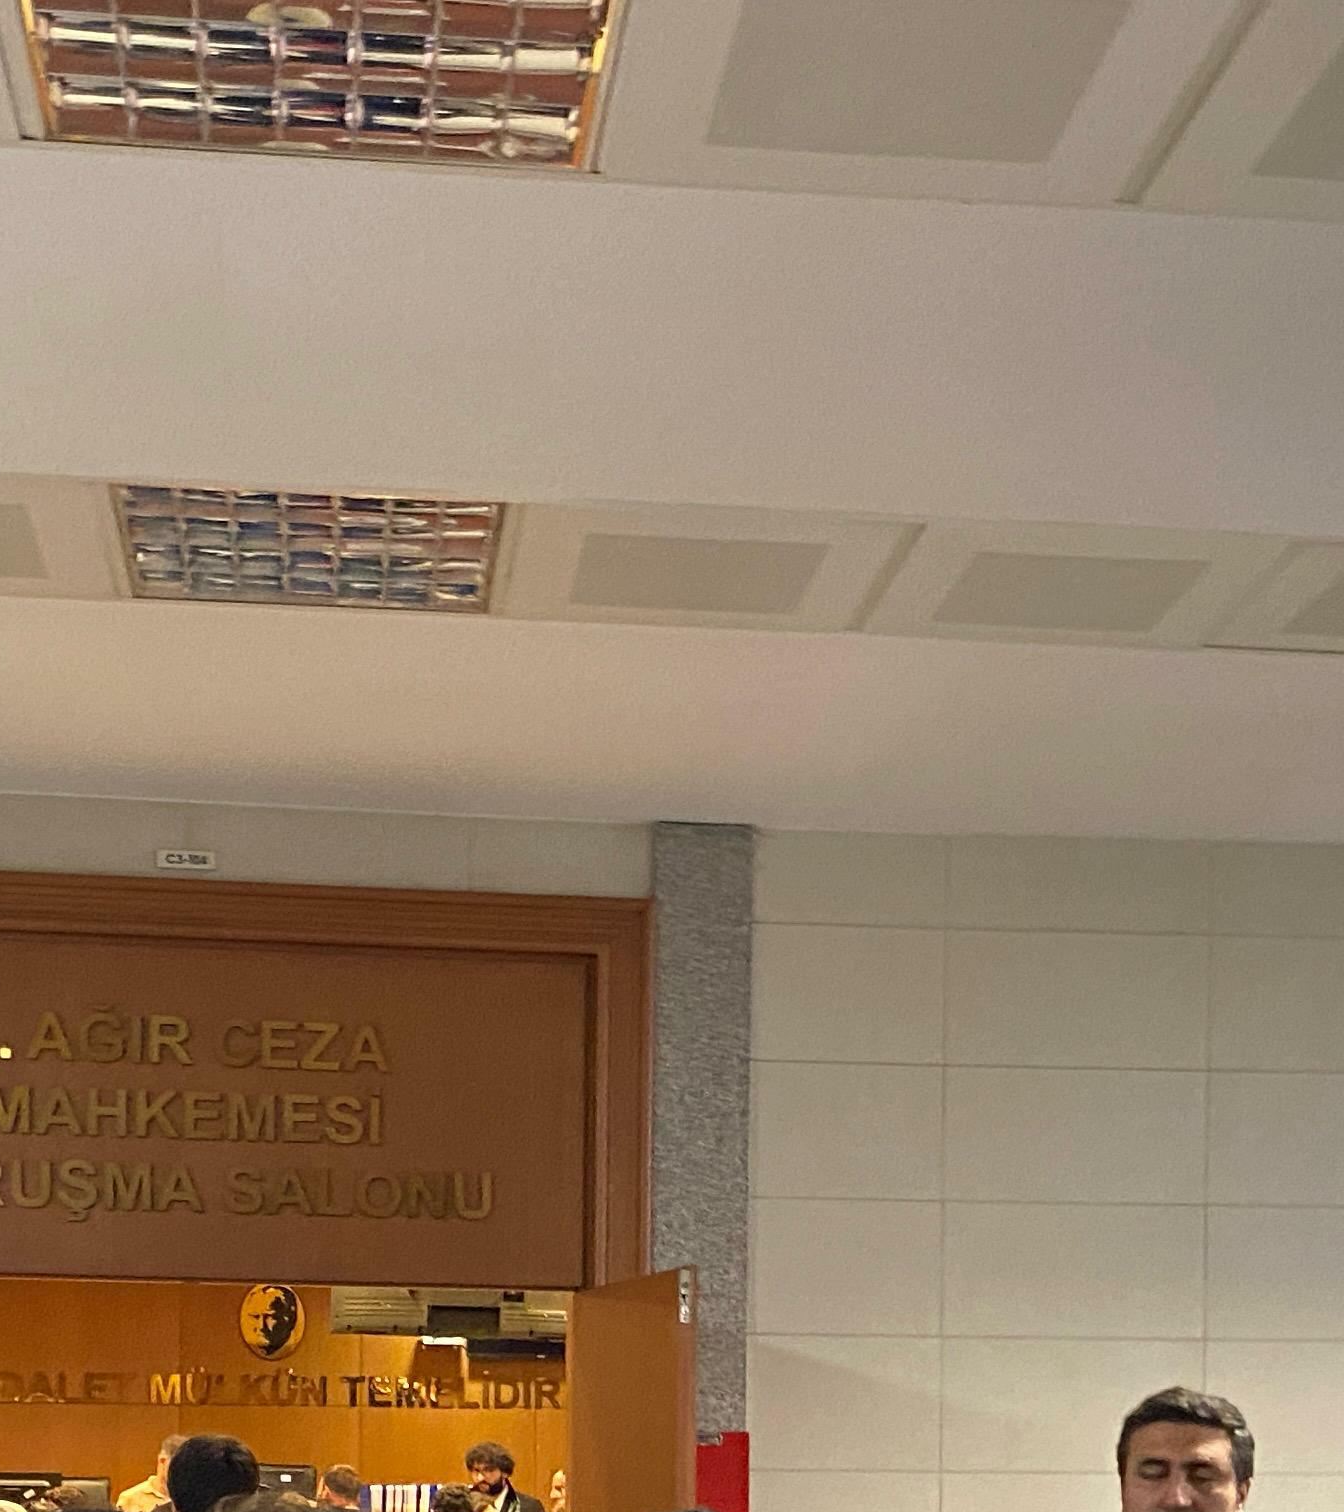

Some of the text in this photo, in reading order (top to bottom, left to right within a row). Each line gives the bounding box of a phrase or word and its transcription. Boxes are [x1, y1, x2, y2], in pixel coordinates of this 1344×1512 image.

[25, 1006, 193, 1066] AĞIR
[222, 1020, 390, 1073] CEZA
[227, 1170, 495, 1221] SALONU
[149, 1366, 329, 1407] MÜKÜN
